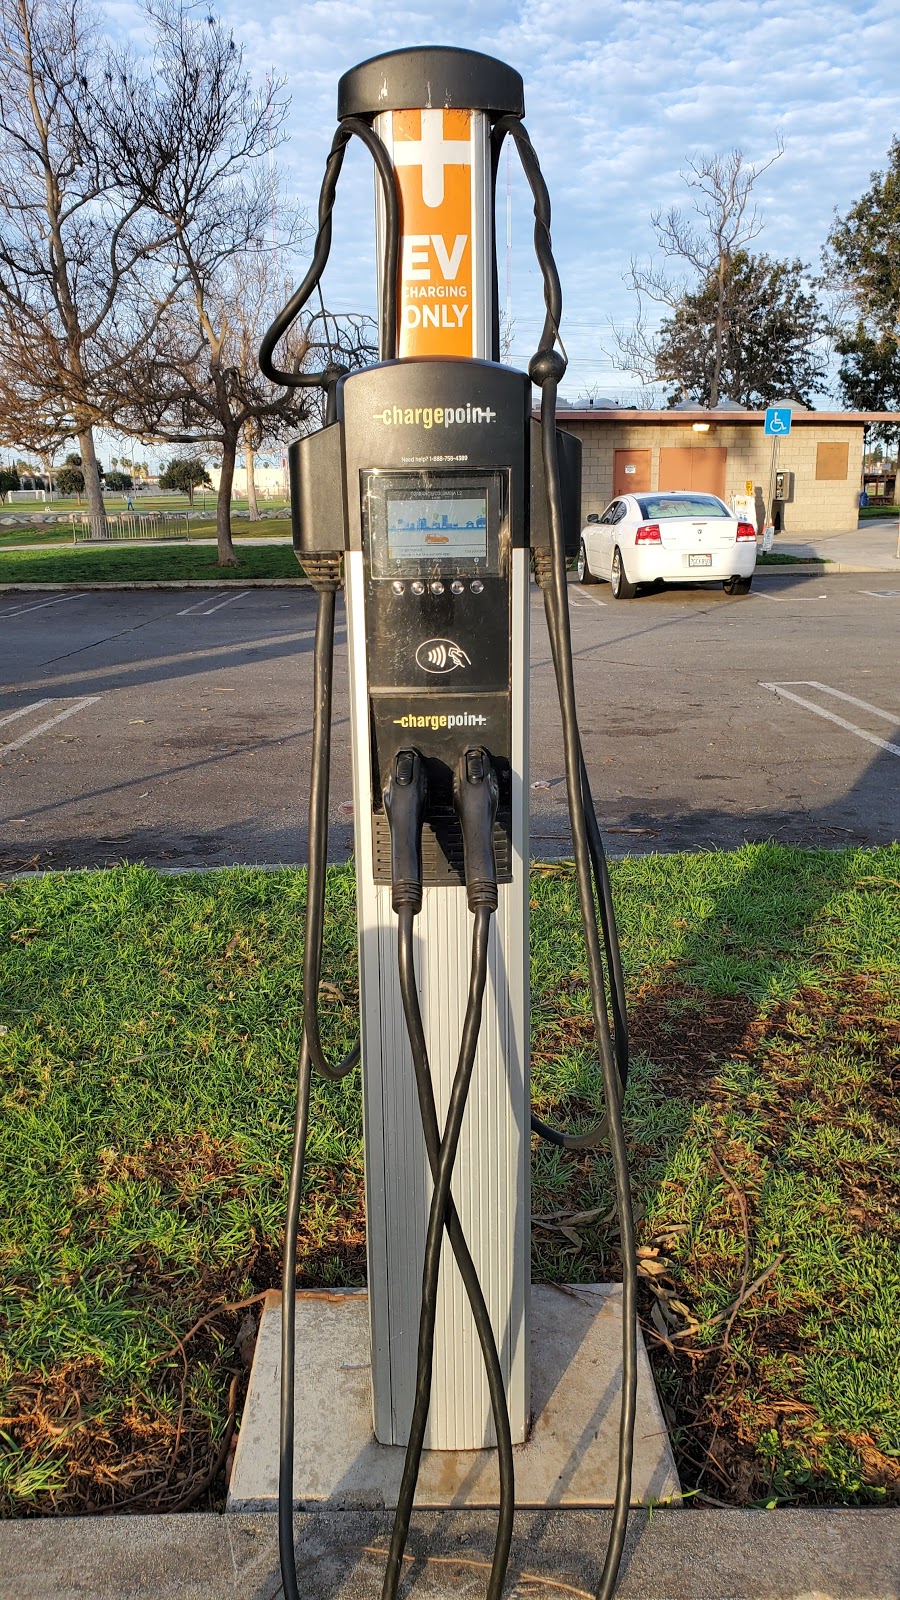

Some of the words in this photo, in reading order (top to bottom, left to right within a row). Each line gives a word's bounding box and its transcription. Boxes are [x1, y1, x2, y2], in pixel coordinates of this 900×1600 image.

[402, 234, 469, 281] EV
[404, 285, 468, 298] CHARGING
[403, 304, 470, 329] ONLY
